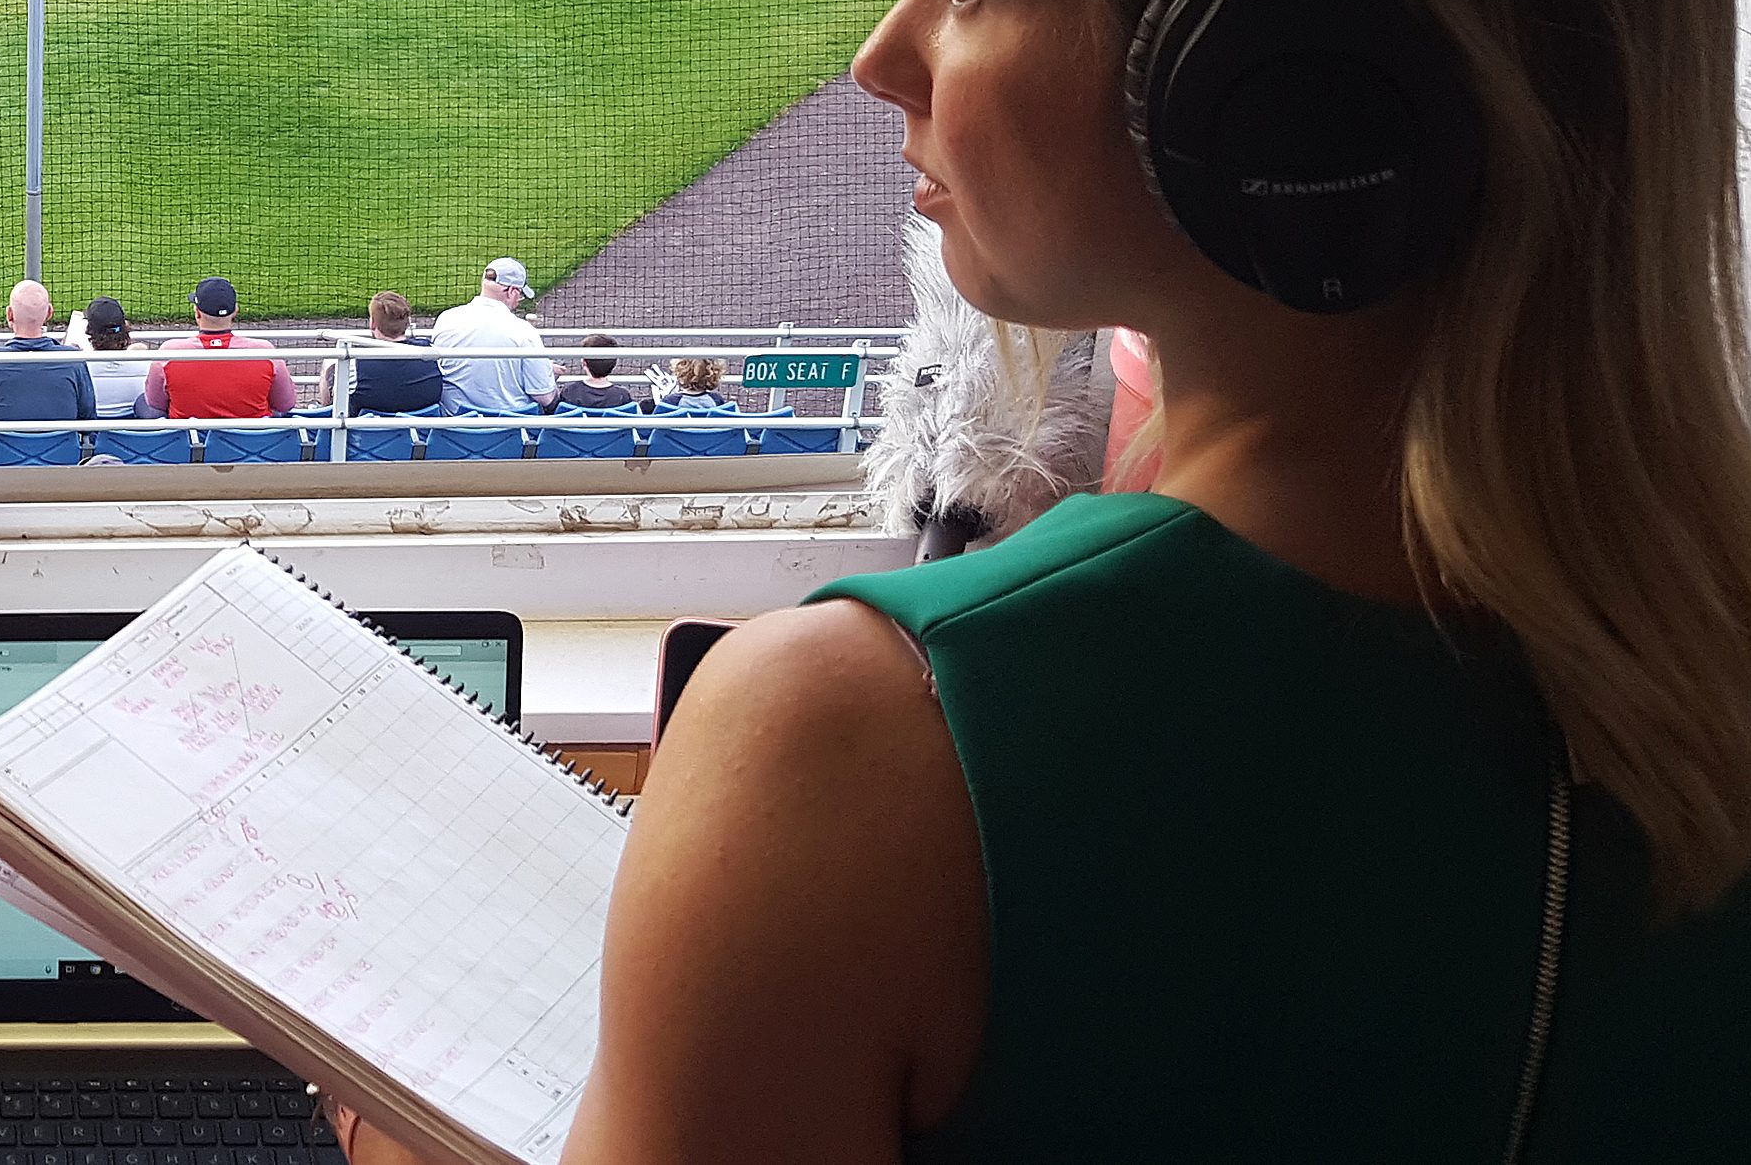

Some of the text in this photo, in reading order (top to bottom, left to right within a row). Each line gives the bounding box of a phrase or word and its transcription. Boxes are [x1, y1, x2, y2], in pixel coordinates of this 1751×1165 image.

[745, 362, 852, 381] BOX SEAT F
